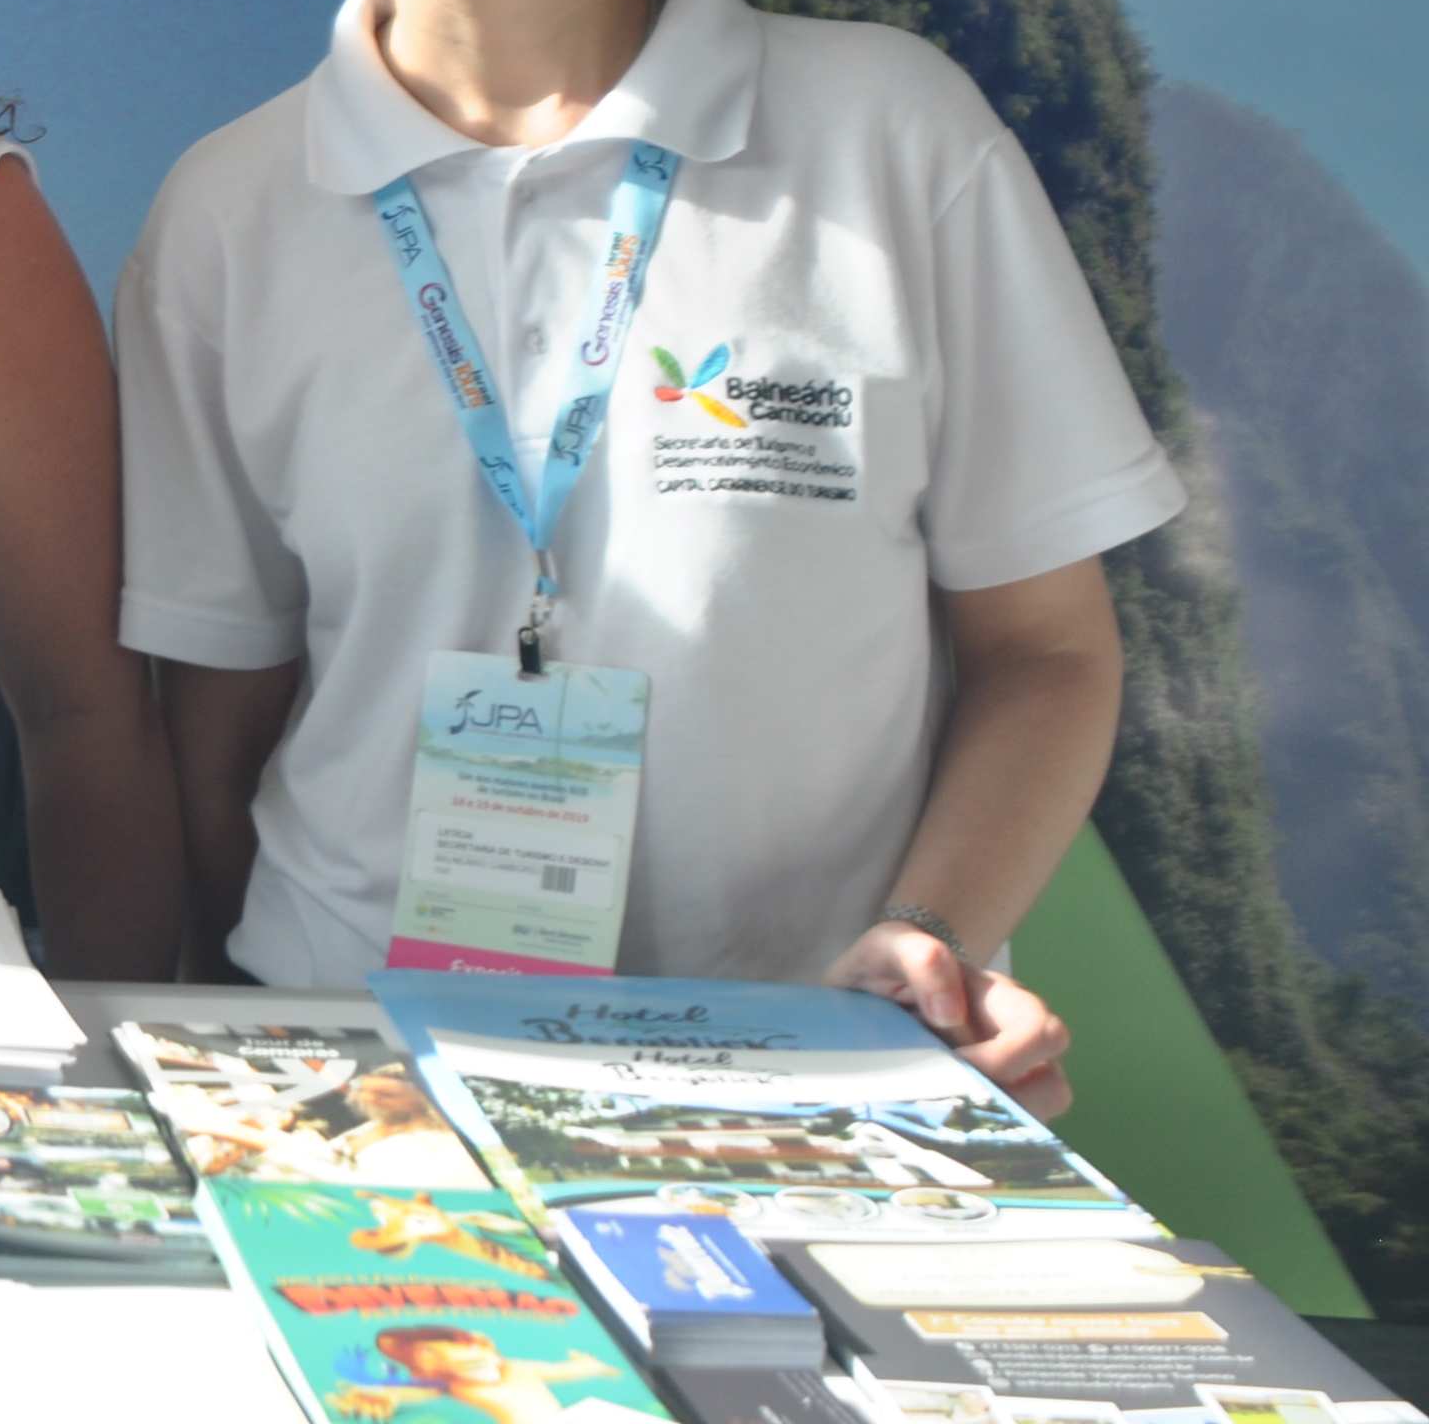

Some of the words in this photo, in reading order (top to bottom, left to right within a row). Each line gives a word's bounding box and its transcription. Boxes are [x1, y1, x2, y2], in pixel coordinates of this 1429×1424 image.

[581, 280, 625, 367] Genesis
[607, 232, 640, 282] Tours
[418, 281, 465, 367] Genesis
[453, 358, 487, 410] Tours
[725, 376, 853, 407] Balneário
[749, 401, 852, 428] Camboriú
[653, 435, 731, 451] Secretaria
[755, 436, 803, 454] Turismo
[566, 1002, 710, 1024] Hotel
[632, 1050, 733, 1066] Hotel
